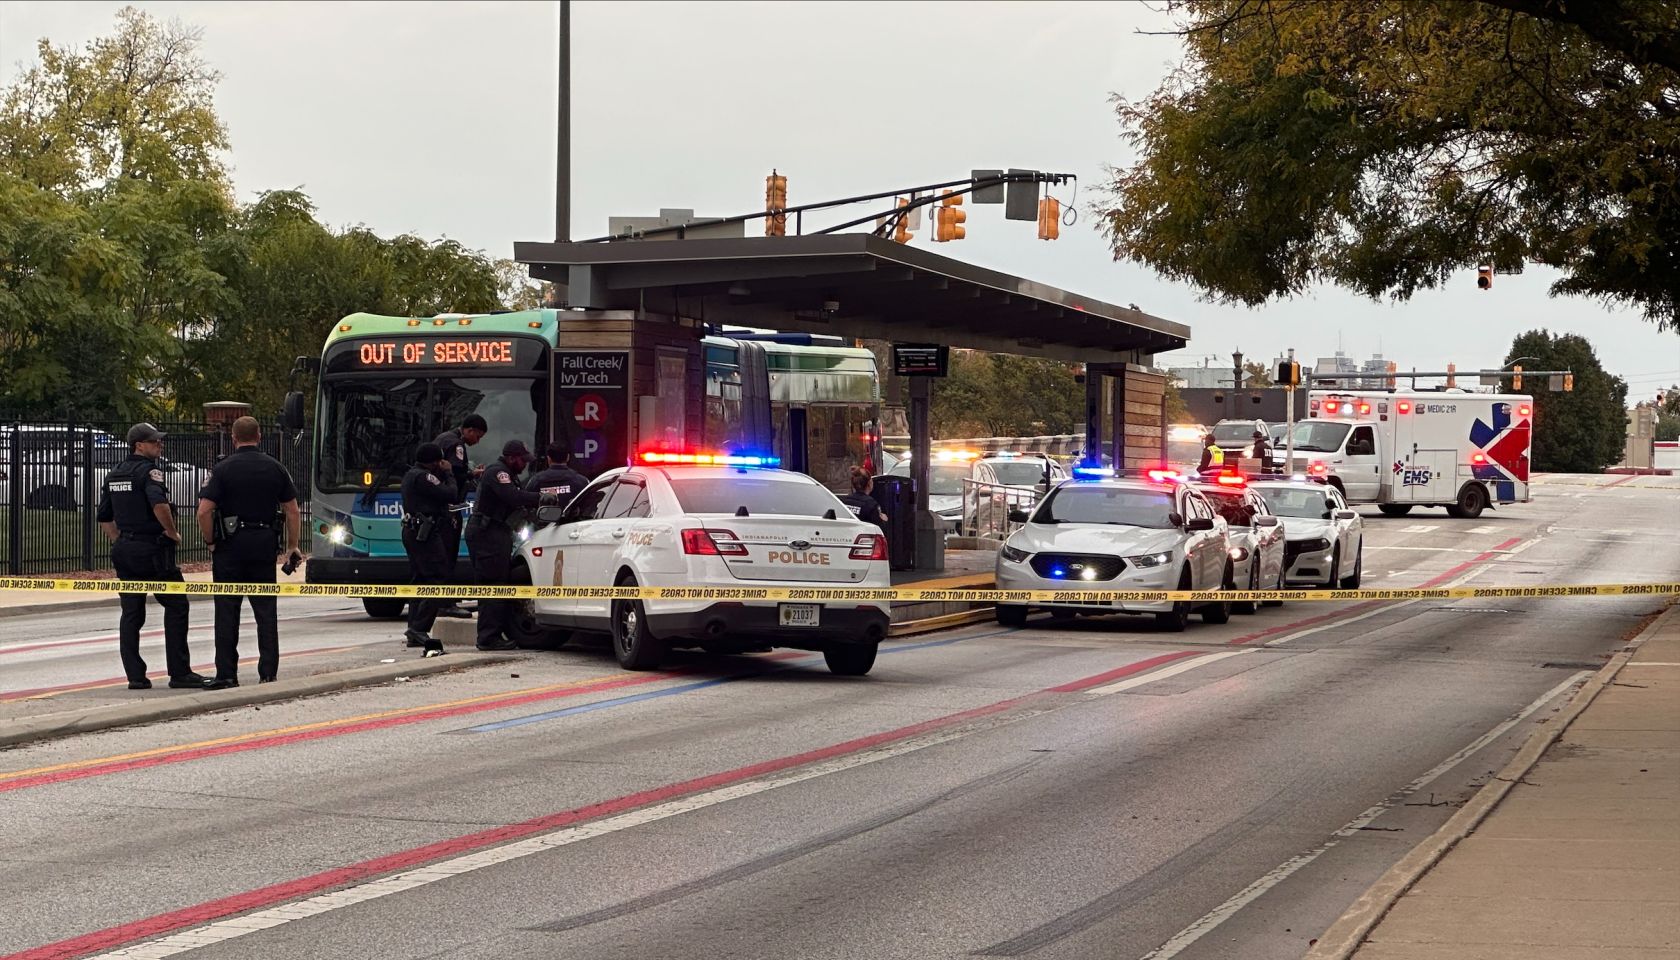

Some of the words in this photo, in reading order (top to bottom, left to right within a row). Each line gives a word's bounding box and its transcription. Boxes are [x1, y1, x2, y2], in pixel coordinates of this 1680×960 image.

[361, 344, 395, 364] OUT
[403, 343, 426, 363] OF
[434, 341, 512, 362] SERVICE
[562, 356, 583, 368] Fall
[585, 356, 624, 371] Creek/
[561, 371, 578, 386] Ivy
[580, 371, 609, 383] Tech
[1427, 406, 1445, 414] MEDIC
[1403, 470, 1429, 485] EMS
[109, 484, 132, 492] POLICE
[629, 532, 654, 546] POLICE
[768, 551, 831, 566] POLICE
[792, 609, 814, 620] 21037
